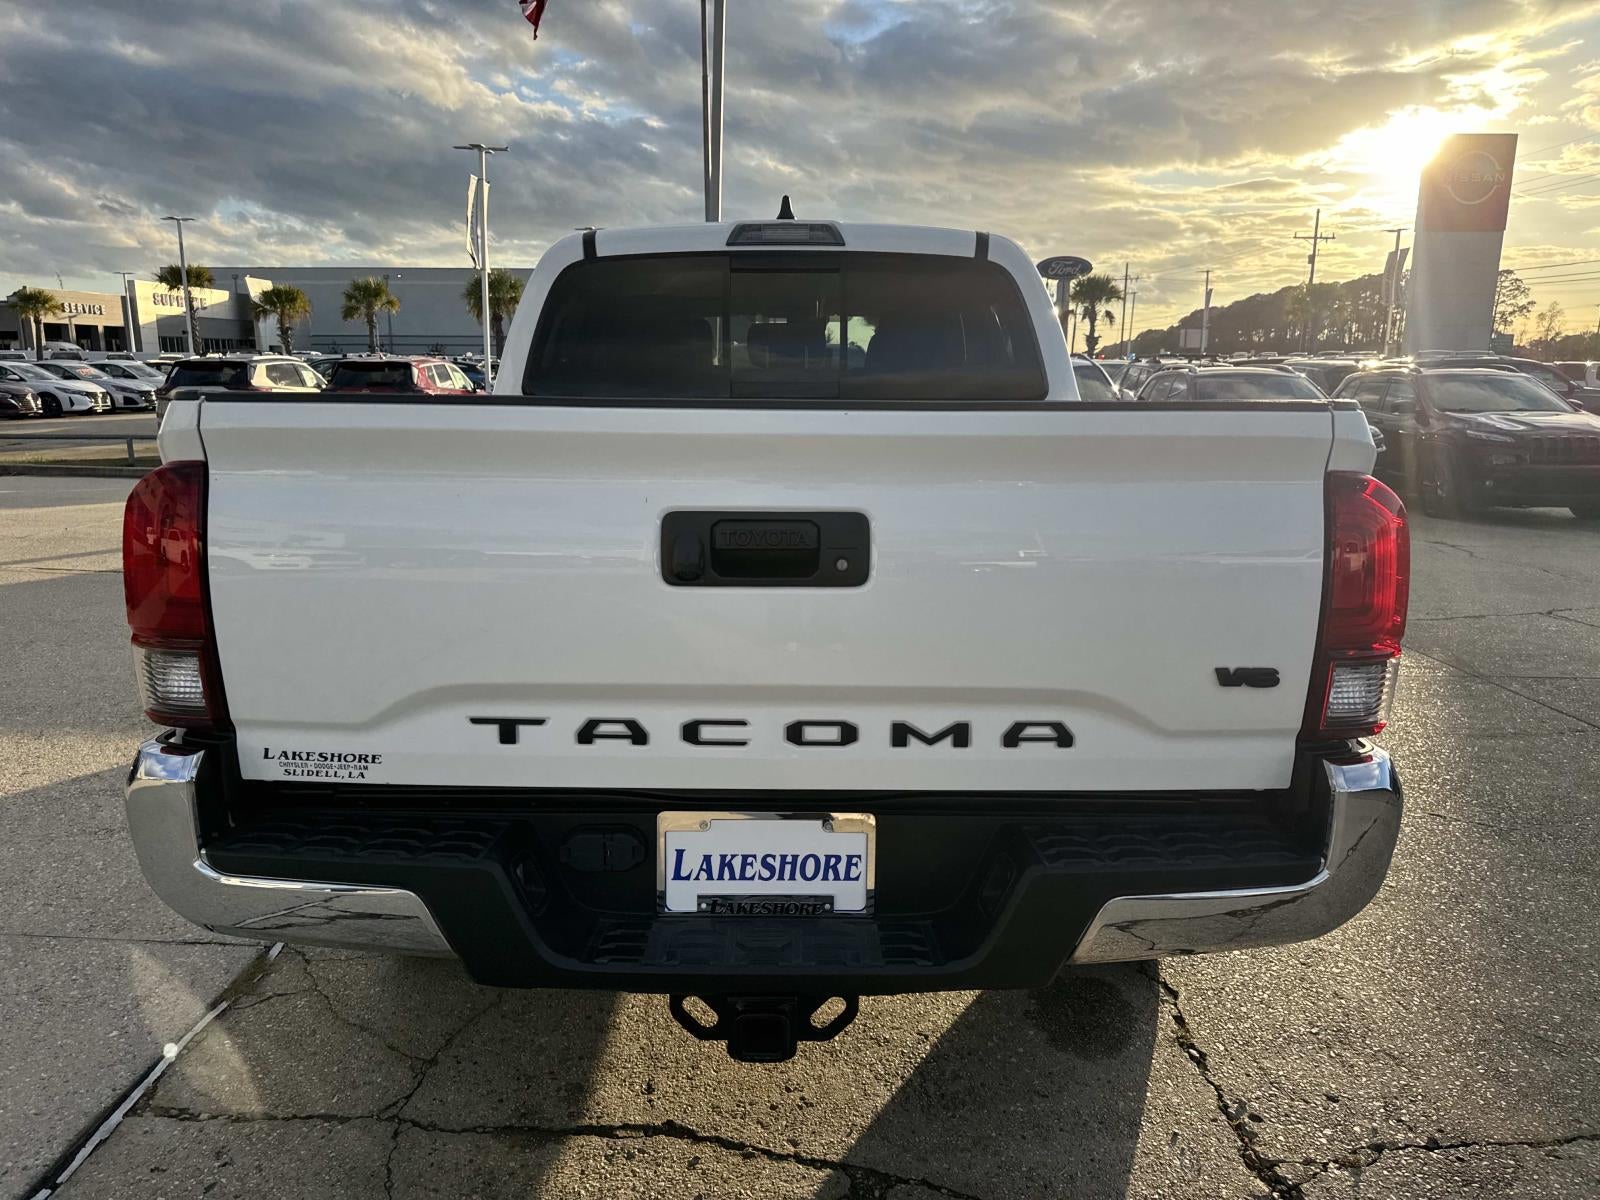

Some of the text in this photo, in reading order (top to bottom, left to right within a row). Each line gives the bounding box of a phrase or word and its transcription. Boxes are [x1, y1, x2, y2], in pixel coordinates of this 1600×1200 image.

[1047, 260, 1082, 276] Ford
[63, 302, 106, 316] SERVICE
[720, 528, 810, 547] TOYOTA
[1214, 667, 1281, 689] V6
[468, 716, 1075, 748] TACOMA
[263, 747, 383, 765] LAKESHORE
[283, 768, 366, 779] SLIDELL, LA
[671, 848, 863, 882] LAKESHORE
[709, 899, 825, 916] LAKESHORE
